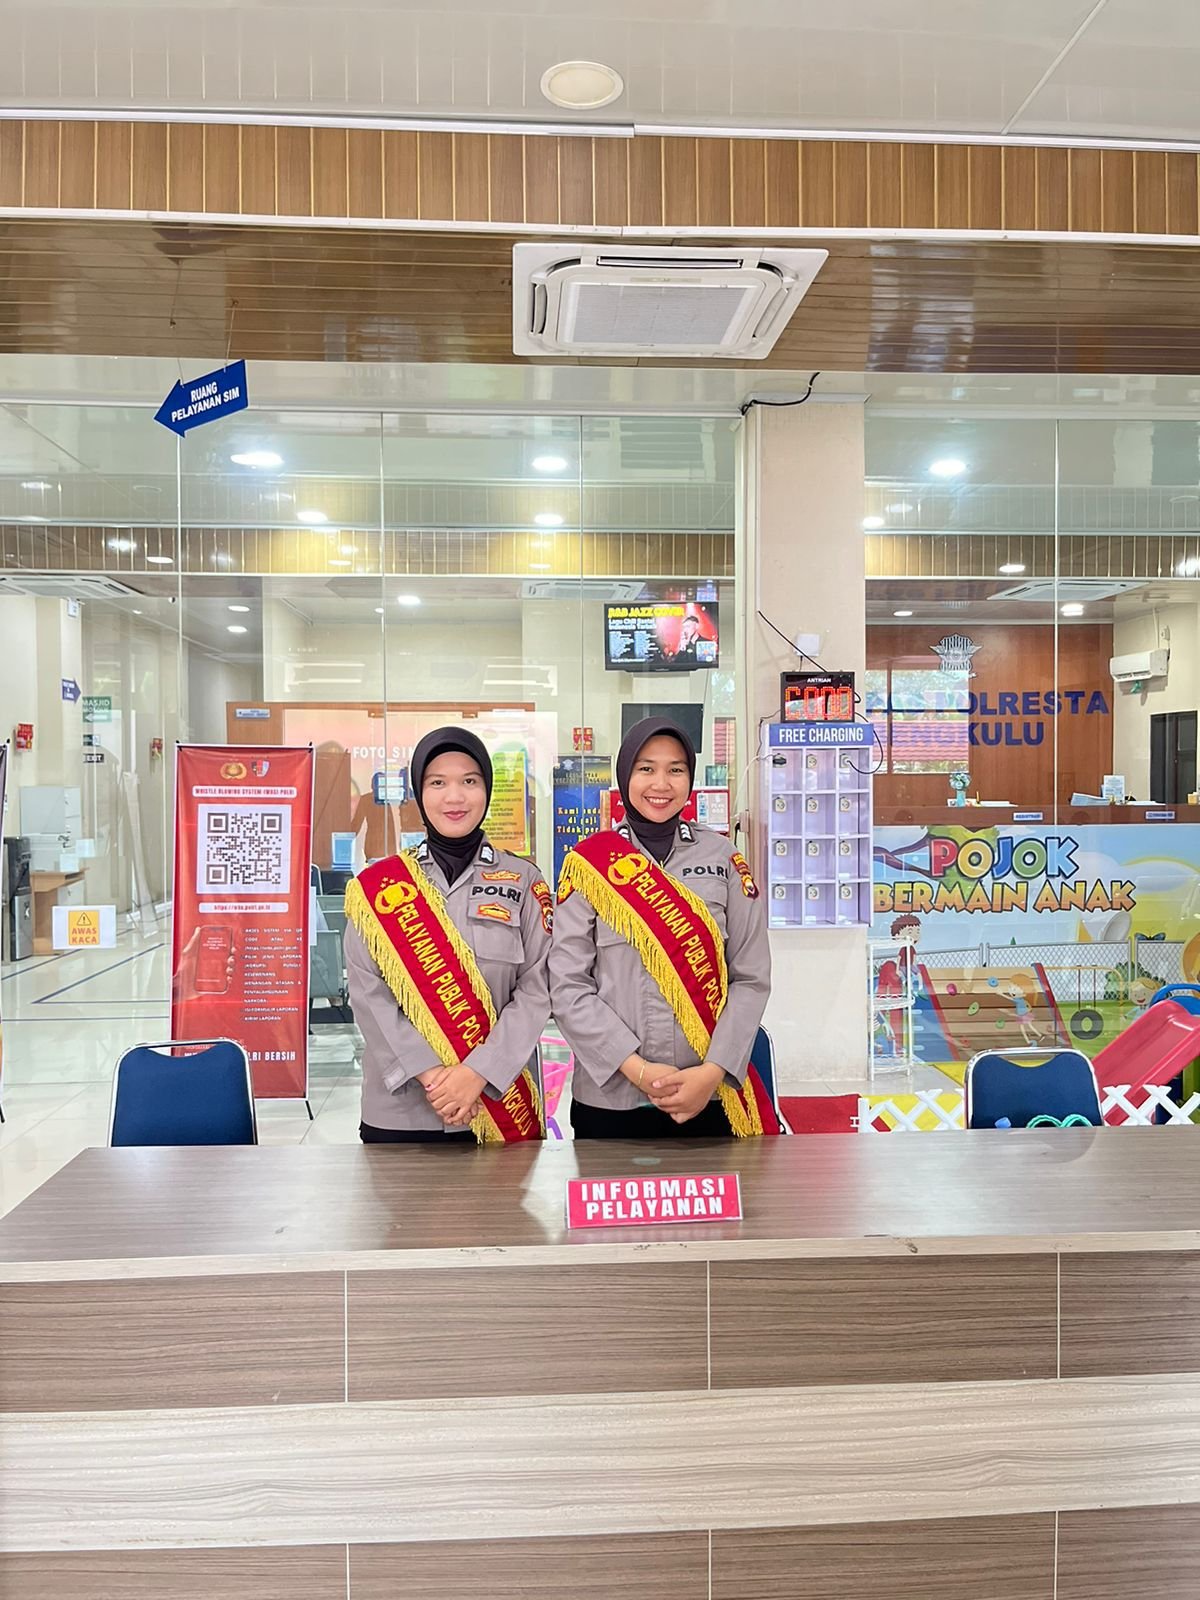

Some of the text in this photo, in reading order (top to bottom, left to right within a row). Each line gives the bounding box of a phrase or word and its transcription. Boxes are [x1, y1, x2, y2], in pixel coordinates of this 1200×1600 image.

[191, 382, 217, 402] RUANG
[171, 387, 240, 422] PELAYANAN SIM
[936, 691, 1109, 715] OLRESTA
[780, 727, 864, 743] FREE CHARGING
[352, 746, 385, 759] FOTO
[558, 807, 579, 815] Kami
[929, 836, 1079, 880] POJOK
[682, 865, 728, 880] POLRI
[472, 886, 521, 902] POLRI
[872, 879, 1137, 913] BERMAIN ANAK
[71, 927, 97, 935] AWAS
[631, 871, 694, 939] PELAYANAN
[681, 934, 713, 982] PUBLIK
[71, 936, 97, 944] KACA
[394, 903, 447, 976] PELAYANAN
[431, 971, 471, 1021] PUBLIK
[264, 1051, 296, 1061] BERSIH
[581, 1177, 725, 1201] INFORMASI
[586, 1196, 723, 1220] PELAYANAN
